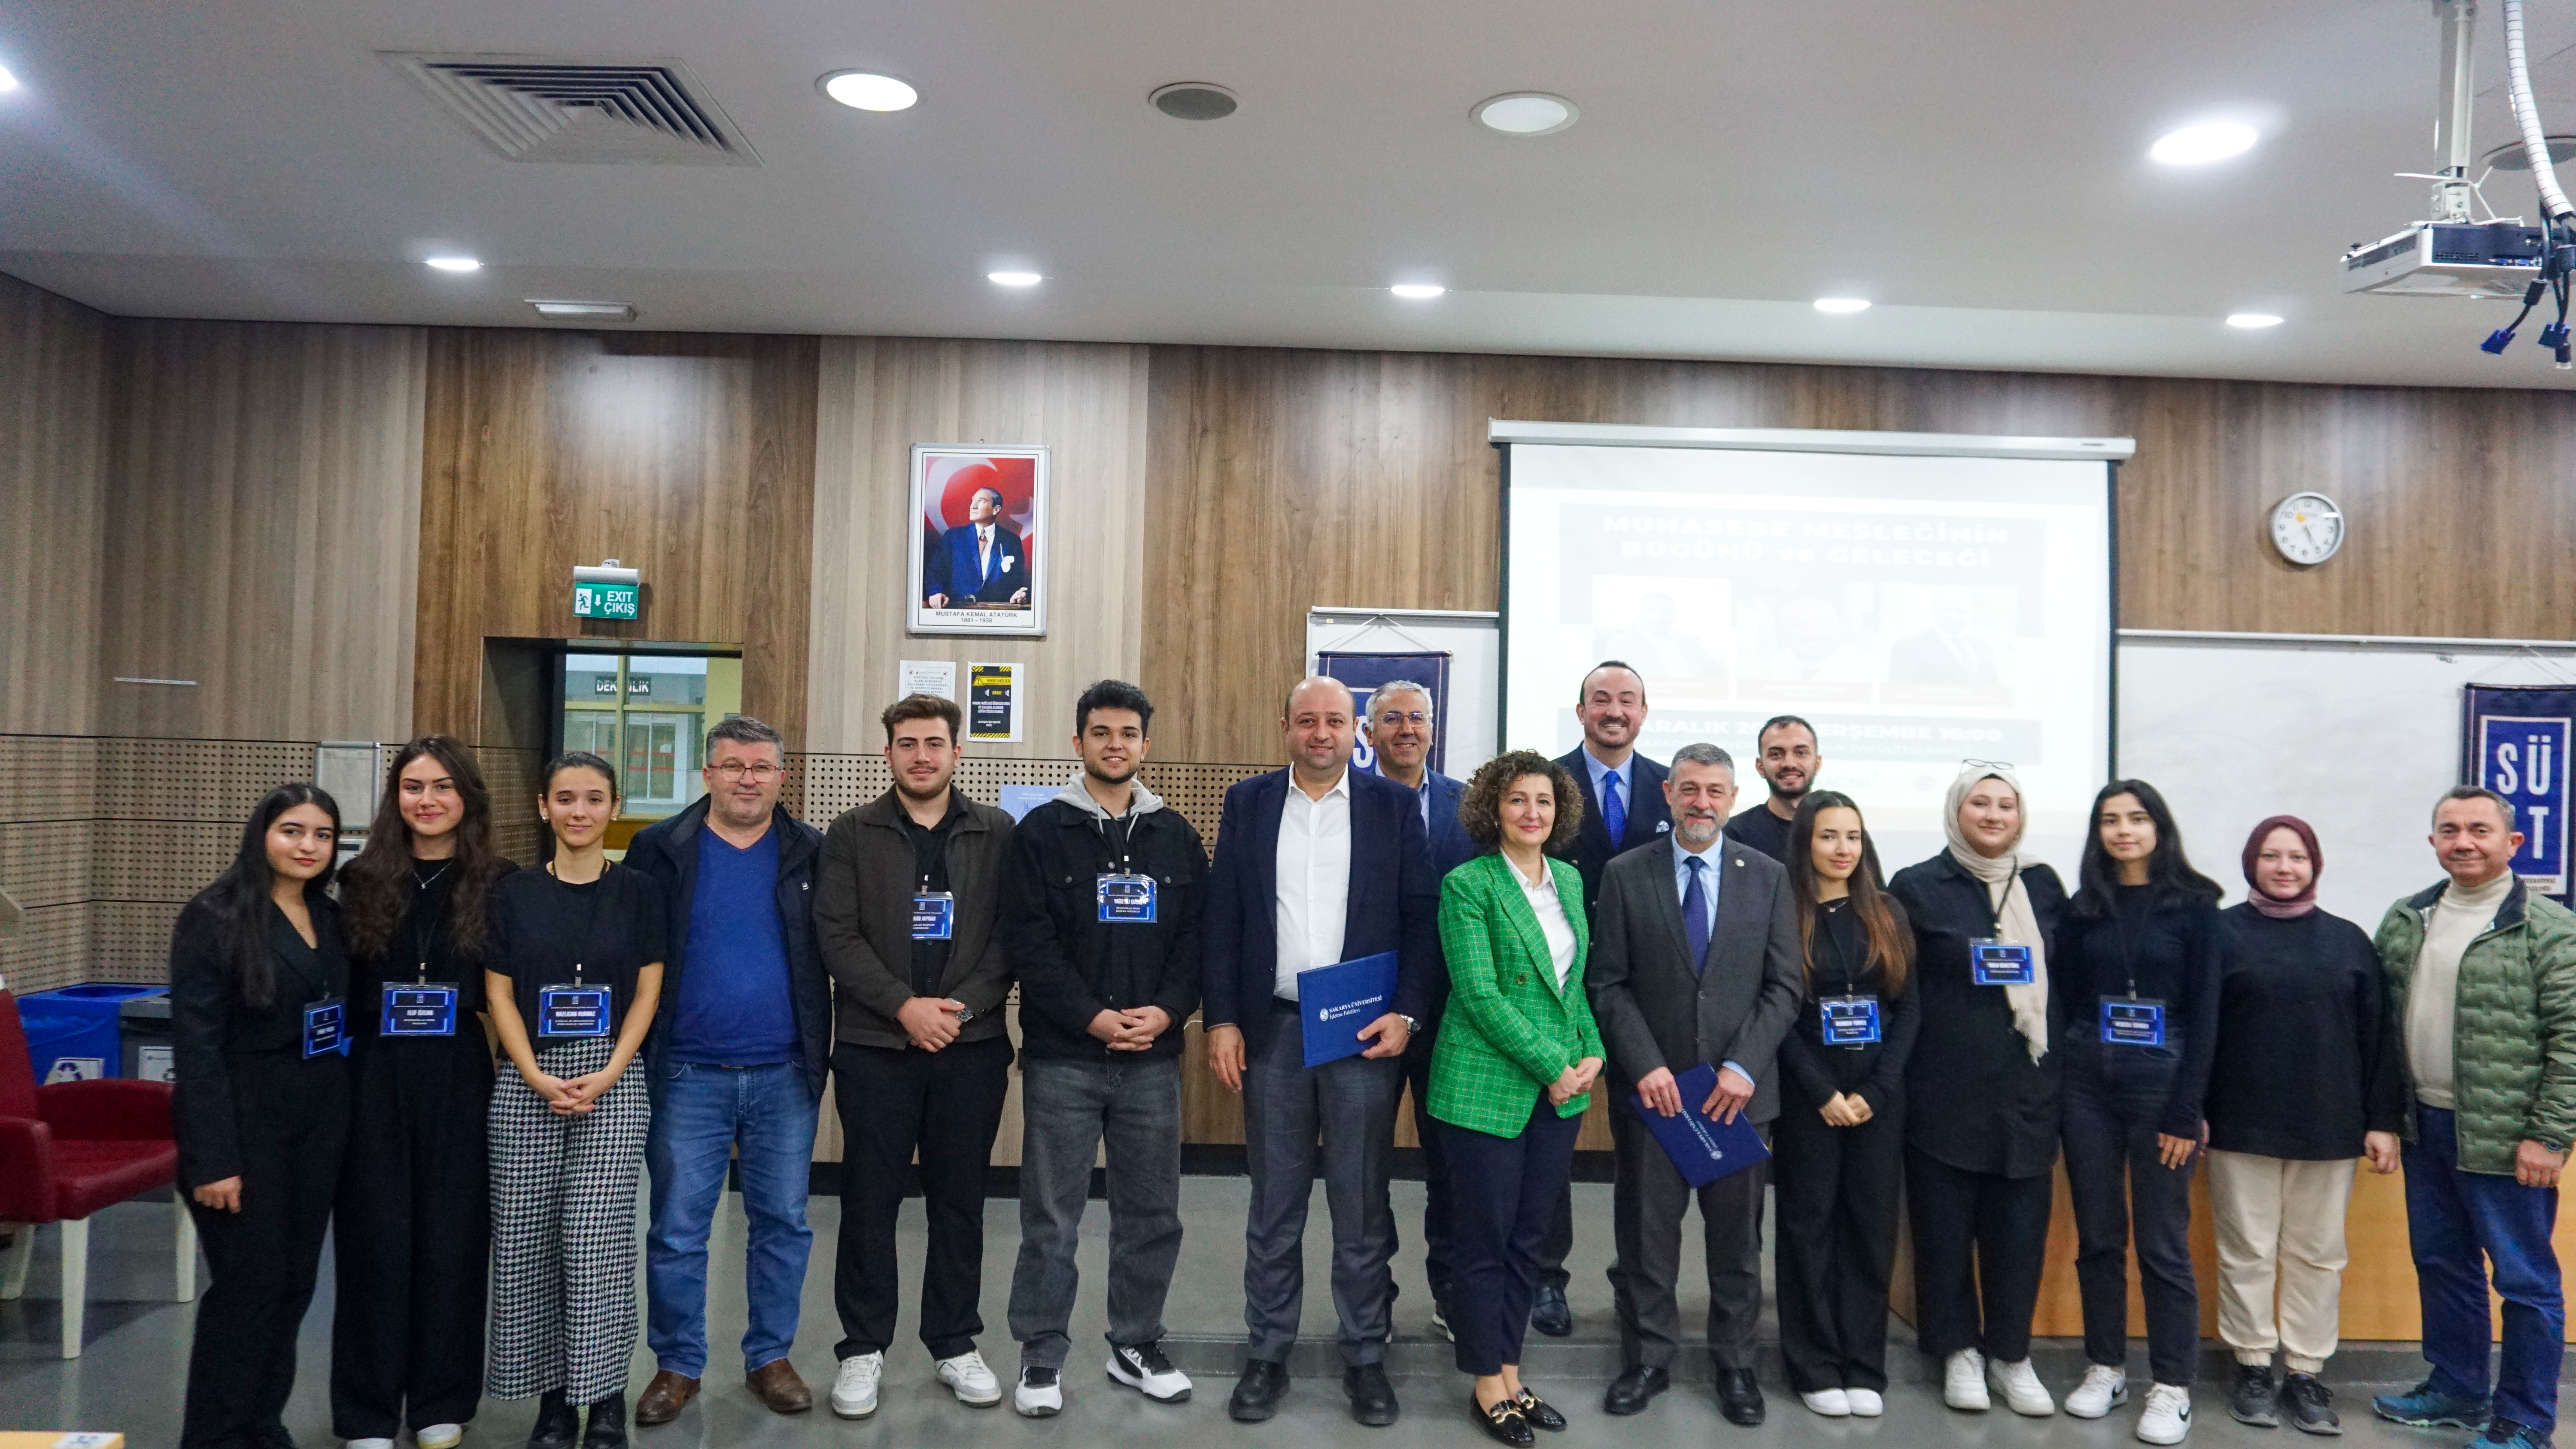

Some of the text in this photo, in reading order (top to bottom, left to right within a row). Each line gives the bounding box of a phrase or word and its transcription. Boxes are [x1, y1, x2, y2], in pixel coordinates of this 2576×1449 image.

[1604, 516, 2008, 543] MUHASEBE MESLEĞİNİN
[1622, 539, 1990, 567] BUGÜNÜ ve GELECEĞİ
[607, 591, 633, 602] EXIT
[604, 602, 635, 616] ÇIKIŞ
[597, 680, 649, 693] DEKLIK
[1641, 720, 1729, 734] ARALIK
[1814, 724, 1932, 741] ERŞEMBE
[1939, 728, 2002, 741] 16:00
[1851, 744, 1922, 754] FAKÜLTESİ
[1925, 746, 1960, 755] AMFİ
[2496, 735, 2551, 795] SÜ
[1329, 995, 1382, 1013] SAKARYA ÜNİVERSİTESİ
[1343, 1008, 1360, 1016] Fakültesi
